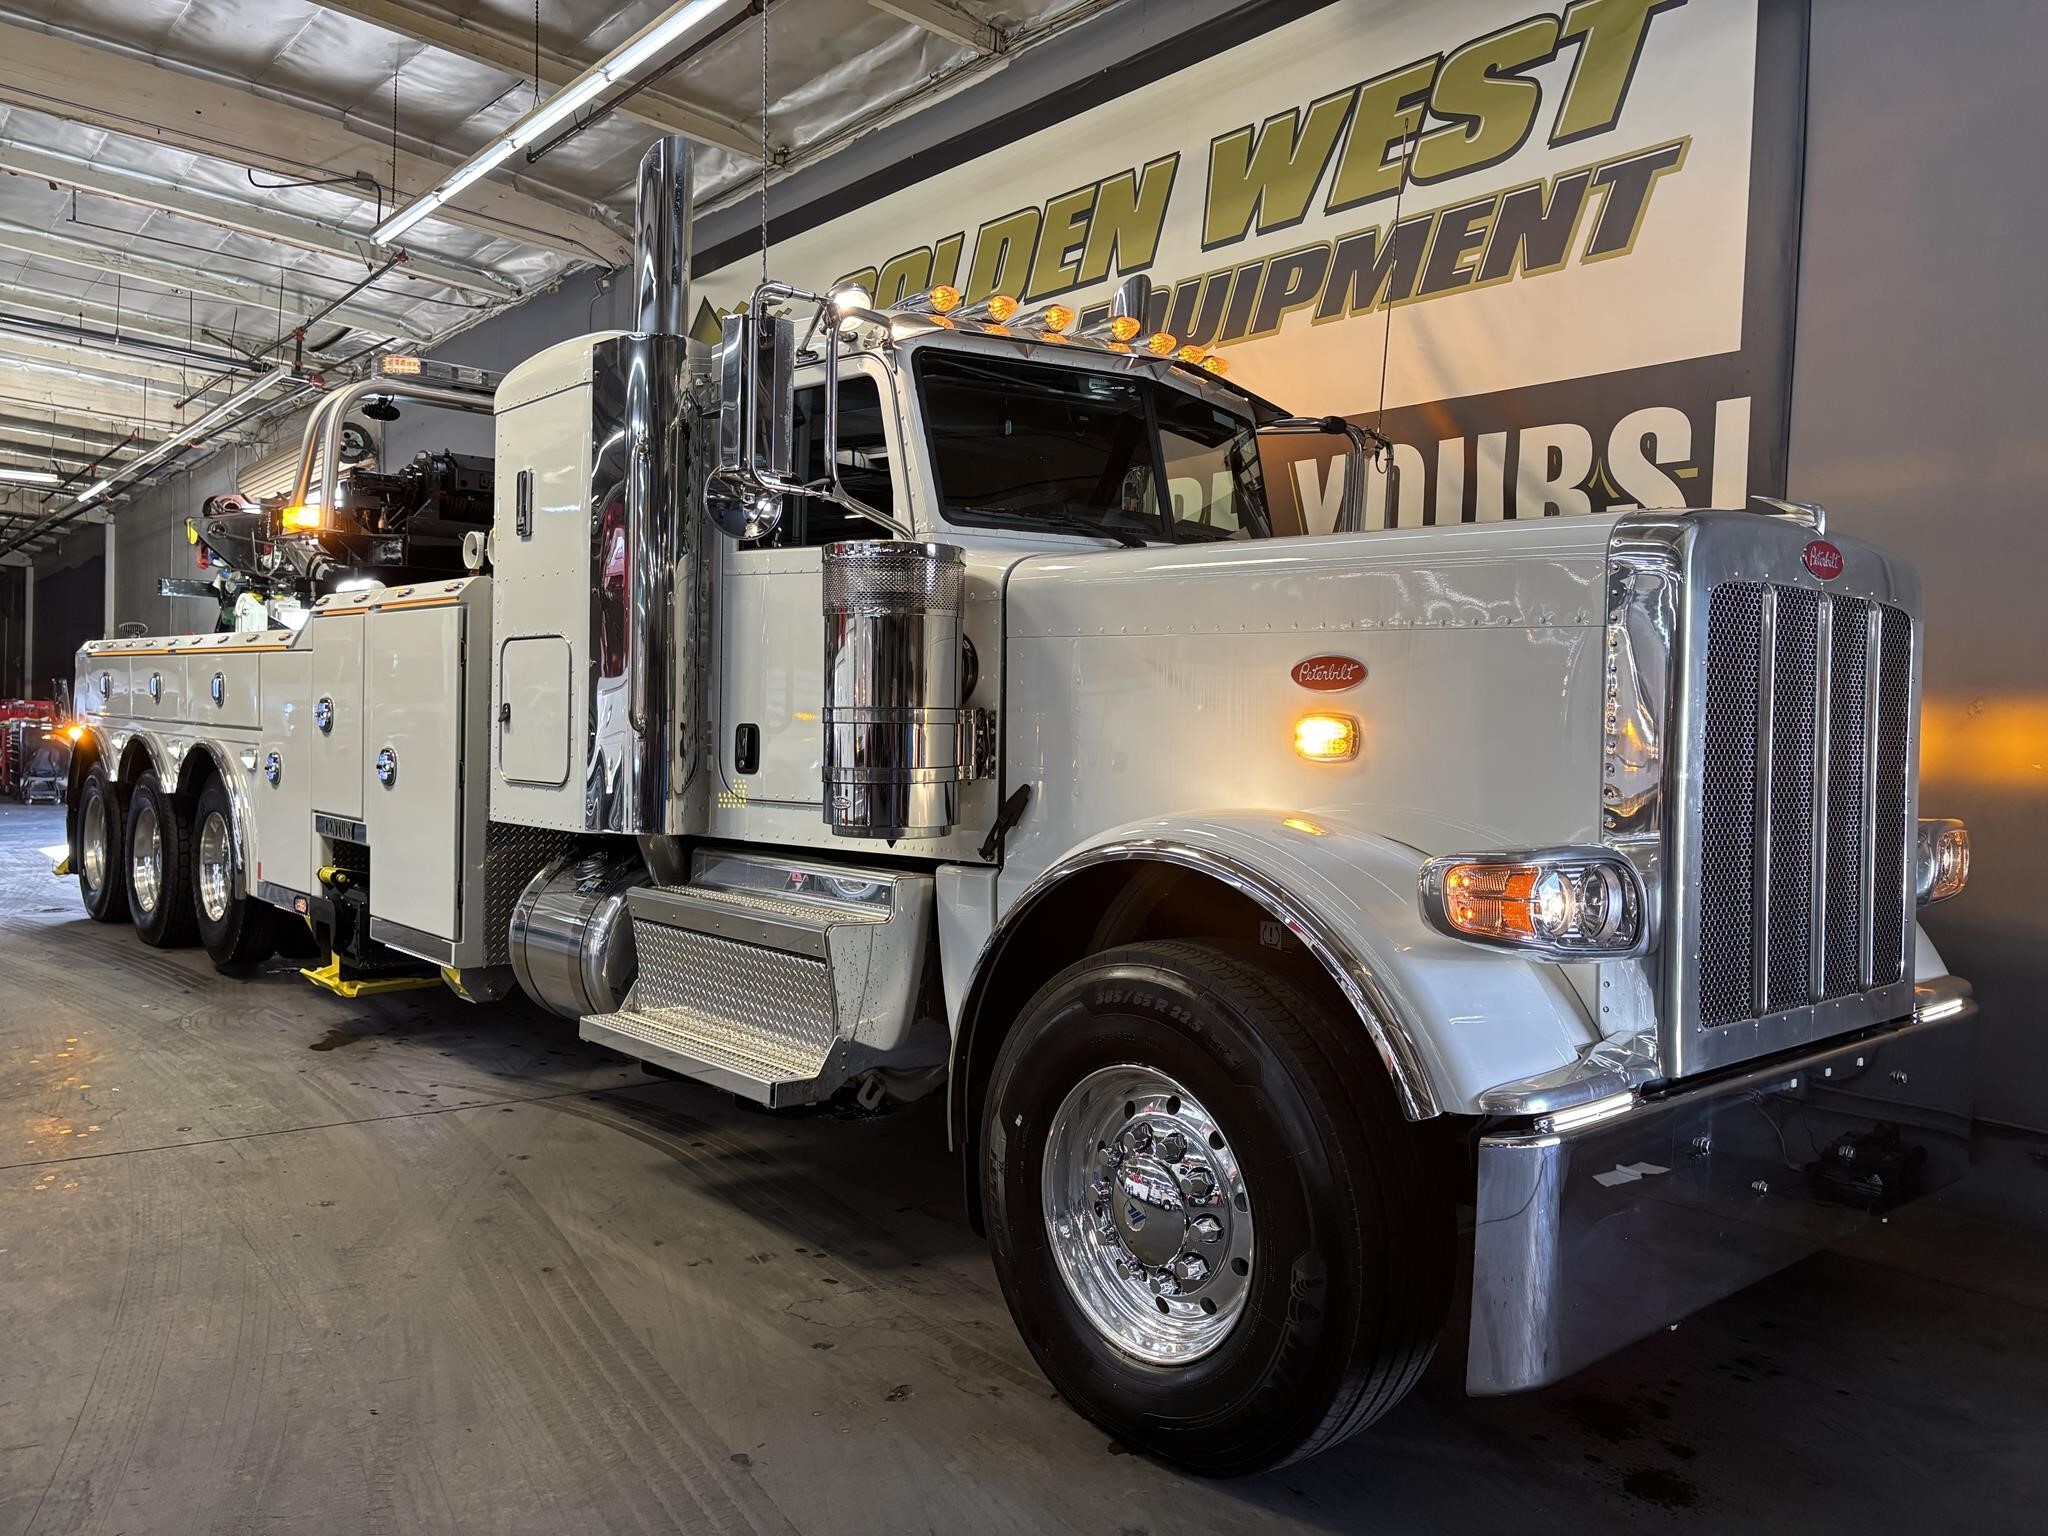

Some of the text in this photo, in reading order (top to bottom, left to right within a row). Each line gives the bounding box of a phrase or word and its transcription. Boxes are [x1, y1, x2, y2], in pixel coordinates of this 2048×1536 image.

[1201, 0, 1690, 252] WEST
[1078, 134, 1693, 350] UIPMENT
[1809, 545, 1841, 569] Peterbilt
[1298, 661, 1360, 683] Peterbilt
[325, 818, 354, 840] CENTURY
